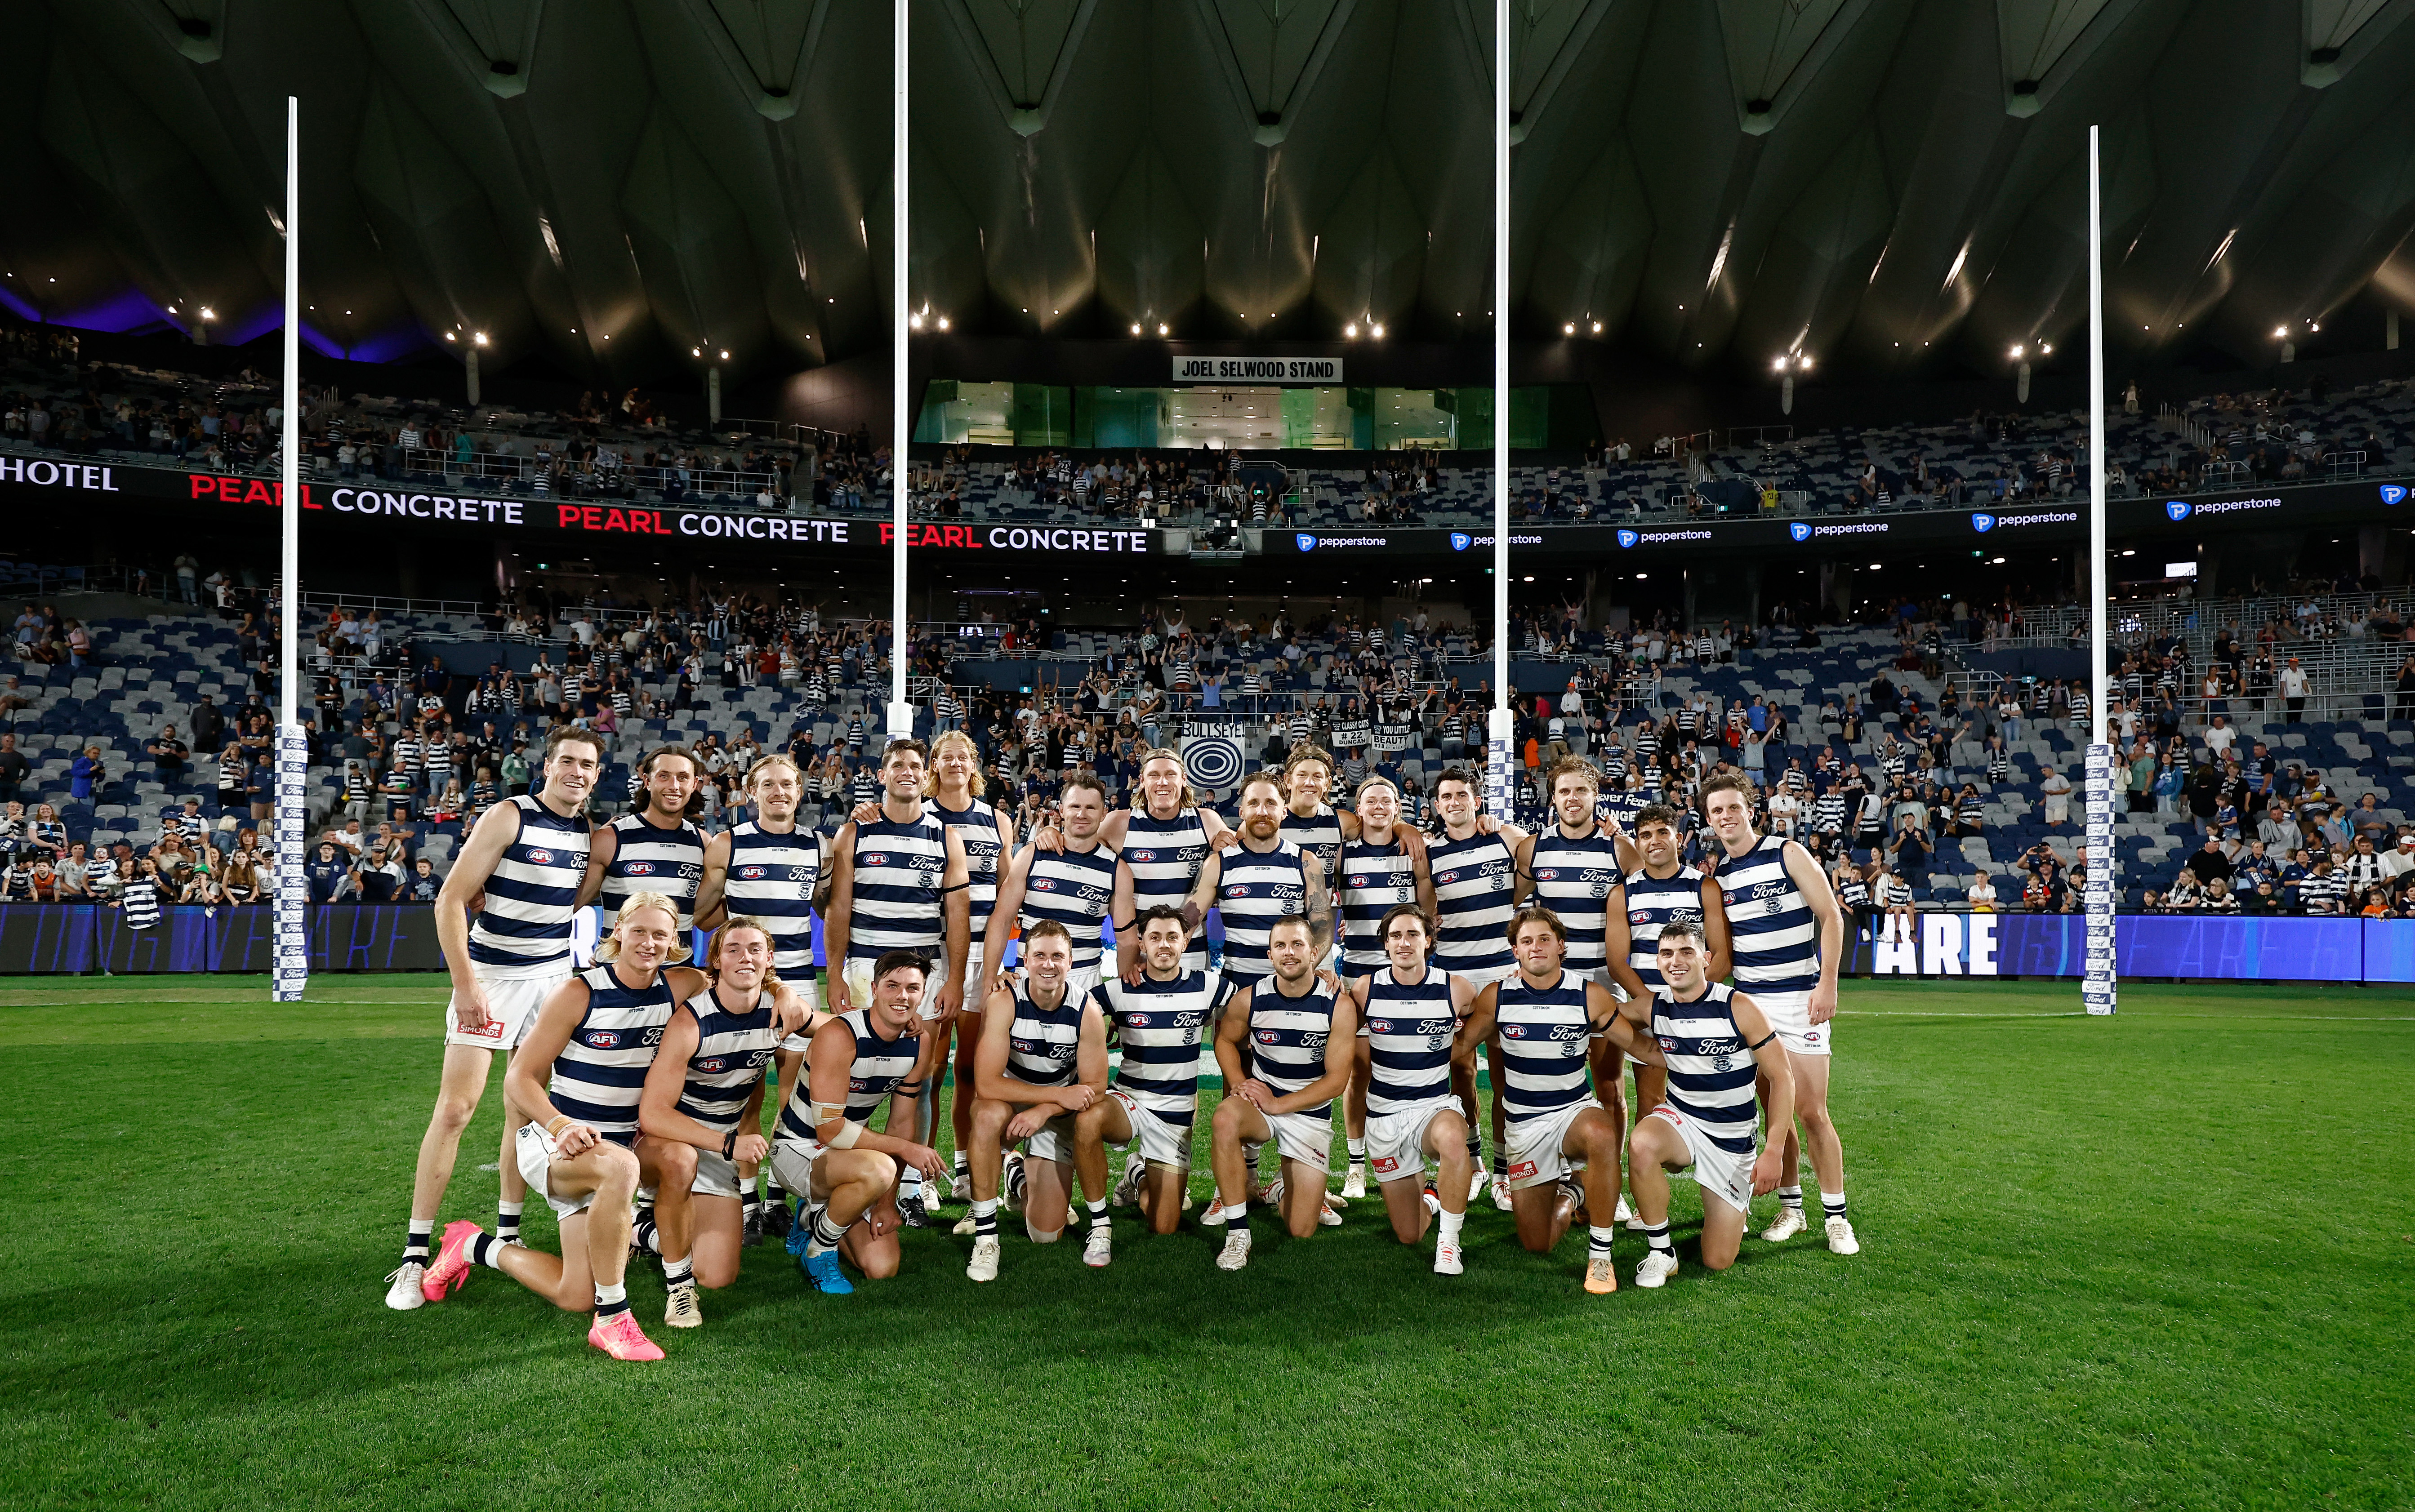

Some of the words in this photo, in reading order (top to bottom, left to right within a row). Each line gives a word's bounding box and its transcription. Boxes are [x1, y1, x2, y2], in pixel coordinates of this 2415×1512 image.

[1182, 361, 1215, 377] JOEL
[1220, 361, 1285, 378] SELWOOD
[1290, 361, 1334, 378] STAND
[0, 457, 119, 491] HOTEL
[189, 475, 323, 510] PEAL
[332, 489, 524, 525] CONCRETE
[2195, 498, 2281, 515] pepperstone
[557, 505, 672, 535] PEARL
[679, 513, 849, 543] CONCRETE
[1998, 511, 2077, 527] pepperstone
[1815, 522, 1888, 537] pepperstone
[878, 523, 983, 548] PEARL
[989, 527, 1147, 553] CONCRETE
[1319, 536, 1386, 547] pepperstone
[1474, 534, 1542, 546] peprstone
[1641, 529, 1711, 543] pepperstone
[1182, 722, 1246, 738] BULLSEYE!
[1341, 721, 1357, 730] CLASSY
[1358, 719, 1369, 728] CATS
[1394, 725, 1411, 734] LITTLE
[286, 739, 305, 749] Ford
[1374, 735, 1408, 744] BEAUTY
[286, 751, 304, 760] Ford
[2086, 746, 2104, 756] Ford
[286, 762, 303, 772] Ford
[2087, 758, 2104, 767] Ford
[2086, 769, 2105, 778] Ford
[2087, 780, 2104, 789] Ford
[1595, 793, 1623, 803] ever
[1625, 794, 1650, 808] Fear
[2086, 791, 2104, 800] Ford
[1595, 805, 1640, 822] DANGE
[2086, 814, 2105, 823] Ford
[2087, 826, 2104, 835] Ford
[2087, 836, 2104, 845] Ford
[969, 841, 1001, 858] Ford
[1176, 847, 1205, 861] Ford
[1316, 844, 1338, 858] Ford
[2087, 848, 2104, 857] Ford
[528, 851, 553, 861] AFL
[570, 853, 588, 869] For
[865, 854, 887, 864] AFL
[1132, 851, 1155, 861] AFL
[626, 864, 654, 873] AFL
[909, 855, 942, 873] Ford
[1479, 860, 1510, 876] Ford
[2087, 859, 2105, 868] Ford
[677, 864, 703, 881] Ford
[741, 867, 766, 877] AFL
[788, 867, 816, 883] Ford
[1439, 872, 1458, 883] AFL
[1537, 870, 1558, 880] AFL
[1579, 868, 1617, 884] Ford
[1350, 876, 1368, 886] AFL
[1387, 872, 1412, 886] Ford
[1034, 880, 1055, 890] AFL
[1751, 881, 1787, 899] Ford
[2087, 881, 2105, 891] Ford
[1077, 885, 1109, 903] Ford
[1228, 886, 1249, 897] AFL
[1270, 884, 1304, 899] Ford
[1724, 894, 1735, 903] AFL
[285, 900, 303, 910] Ford
[2087, 904, 2105, 913] Ford
[1631, 912, 1650, 923] AFL
[1669, 908, 1703, 923] Ford
[285, 923, 303, 932] Ford
[2087, 926, 2105, 936] Ford
[285, 935, 302, 943] Ford
[1874, 913, 1997, 975] ARE
[285, 946, 304, 956] Ford
[2088, 949, 2105, 958] Ford
[284, 969, 305, 978] Ford
[2087, 971, 2105, 981] Ford
[2086, 994, 2106, 1003] Ford
[1127, 1014, 1149, 1025] AFL
[1173, 1012, 1203, 1027] Ford
[459, 1023, 499, 1037] SIMONDS
[1370, 1021, 1391, 1031] AFL
[1417, 1019, 1453, 1034] Ford
[1504, 1027, 1524, 1036] AFL
[1257, 1032, 1278, 1042] AFL
[1549, 1025, 1586, 1041] Ford
[588, 1034, 618, 1046] AFL
[1300, 1032, 1327, 1047] For
[1011, 1041, 1033, 1051] AFL
[1659, 1041, 1676, 1051] AFL
[1698, 1039, 1738, 1055] Ford
[1049, 1045, 1076, 1059] For
[747, 1050, 771, 1067] For
[698, 1059, 724, 1071] AFL
[849, 1081, 866, 1090] AFL
[1509, 1168, 1535, 1180] MONDS
